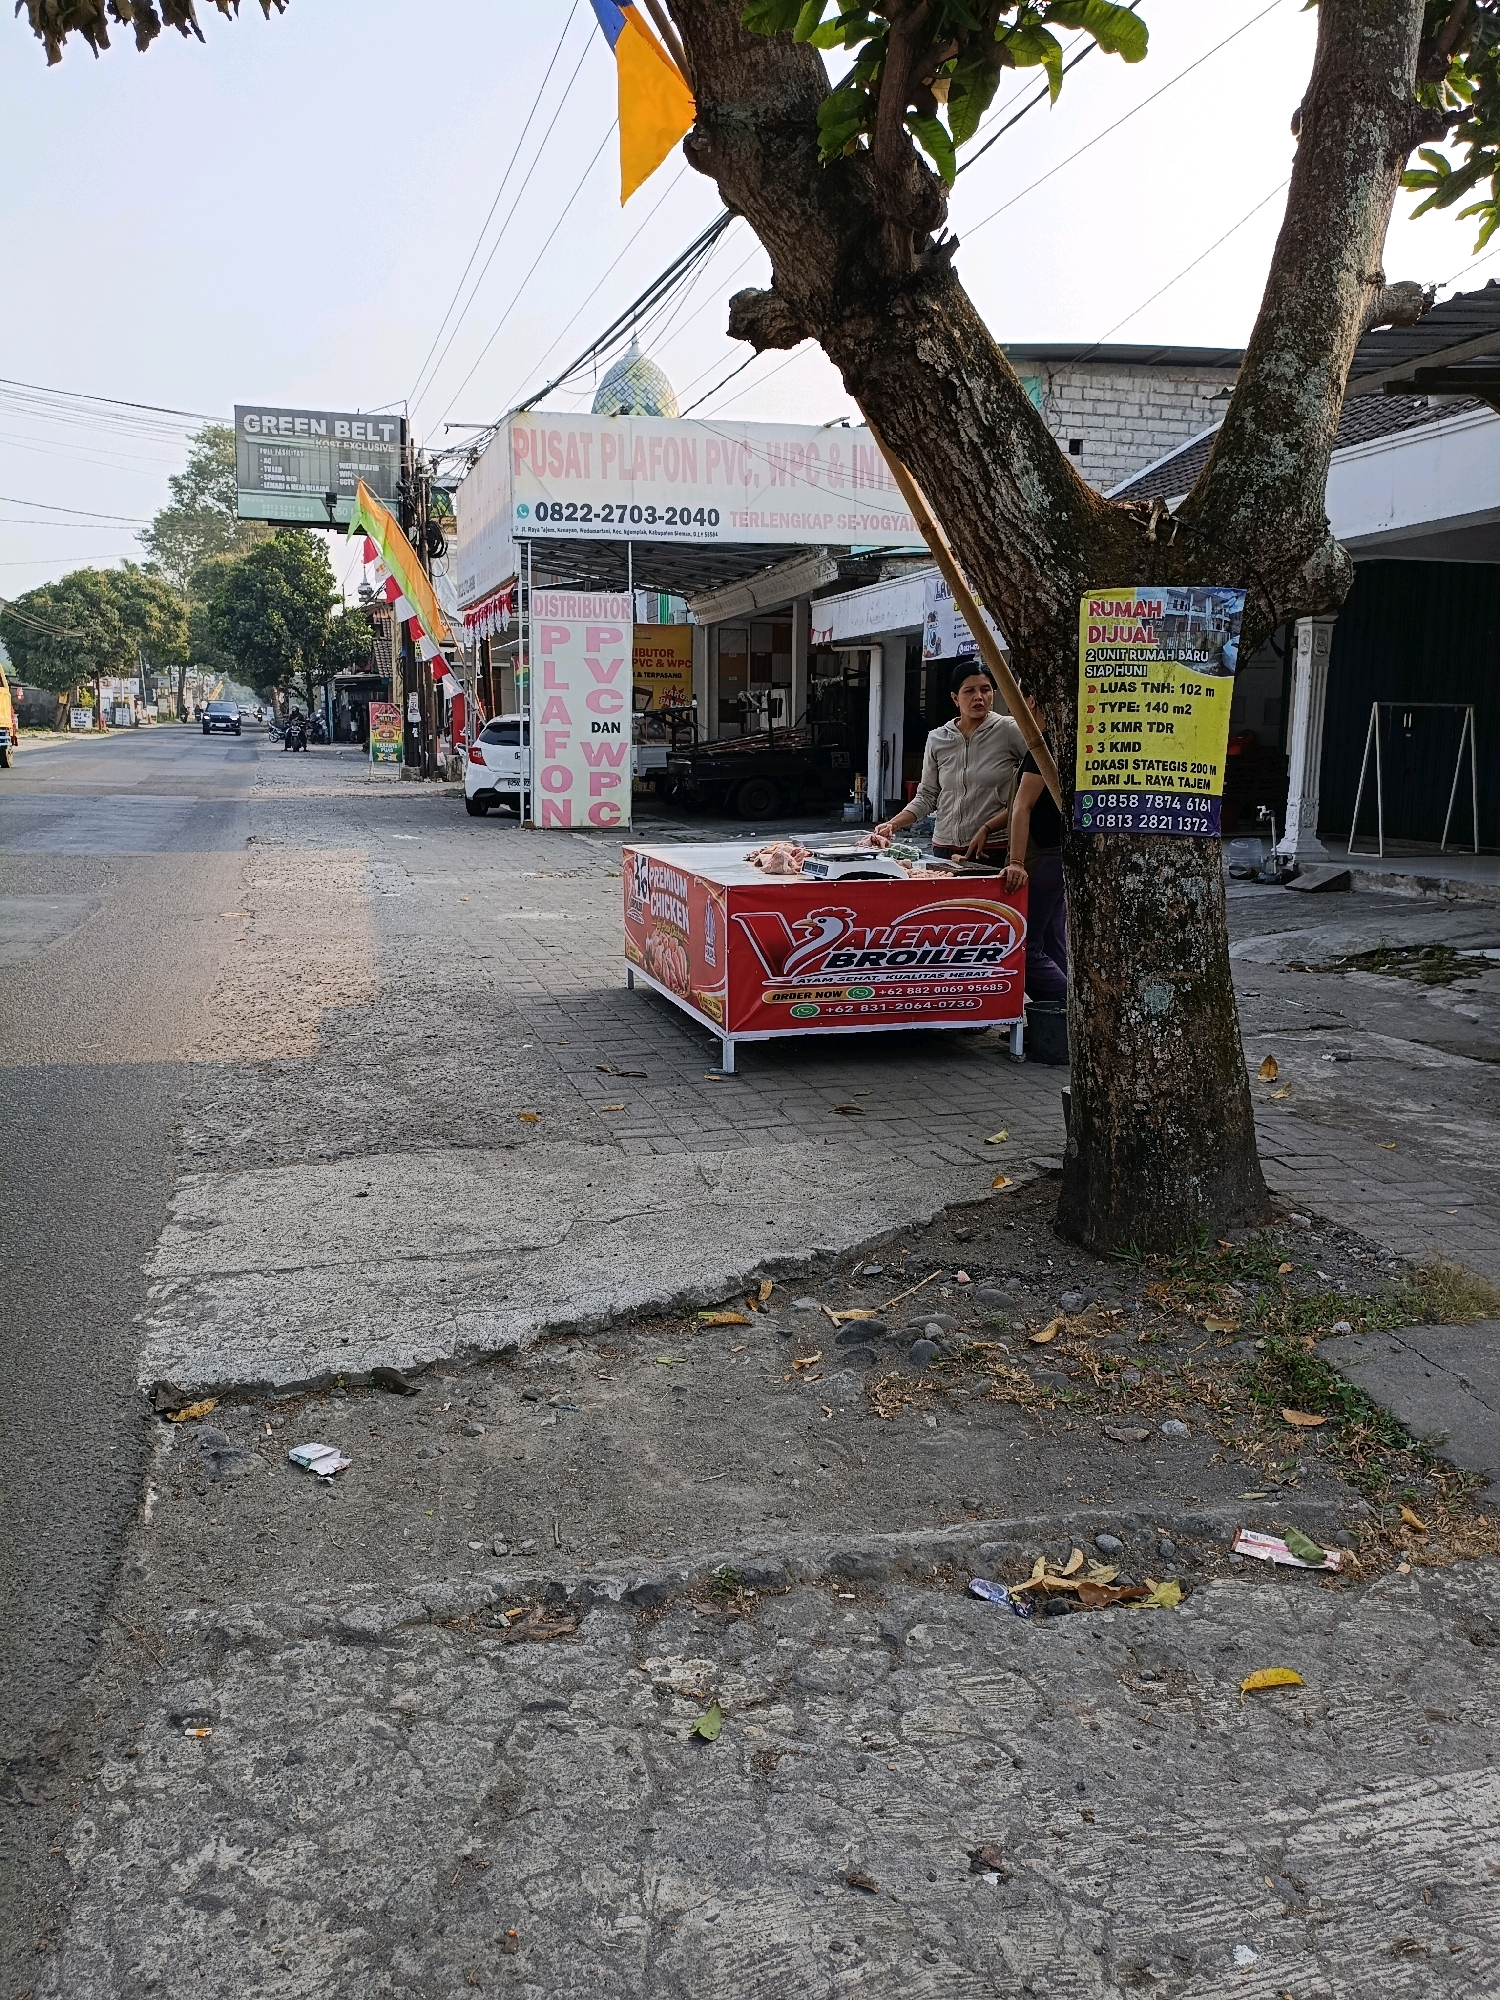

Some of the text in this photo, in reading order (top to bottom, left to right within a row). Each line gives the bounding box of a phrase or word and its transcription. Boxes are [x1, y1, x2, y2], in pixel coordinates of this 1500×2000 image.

[243, 414, 395, 442] GREEN BELT
[315, 439, 395, 453] KOST EXCLUSIVE
[513, 427, 593, 479] PUSAT
[600, 432, 698, 484] PLAFON
[705, 438, 759, 488] PVC,
[766, 441, 820, 488] WPC
[827, 442, 845, 489] &
[535, 501, 720, 527] 0822-2703-2040
[729, 510, 834, 529] TERLENGKAP
[533, 594, 632, 620] DISTRIBUTOR
[1088, 599, 1164, 619] RUMAH
[1088, 624, 1160, 645] DIJUAL
[632, 647, 675, 658] IBUTOR
[1085, 648, 1209, 662] 2 UNIT RUMAH BARU
[656, 658, 665, 668] &
[667, 659, 692, 669] WPC
[1085, 664, 1147, 677] SIAP HUNI
[644, 671, 683, 679] TERPASANG
[1099, 681, 1215, 698] LUAS TNH: 102 m
[1099, 701, 1192, 715] TYPE: 140 m2
[591, 721, 621, 734] DAN
[1097, 720, 1174, 734] 3 KMR TDR
[1096, 740, 1142, 754] 3 KMD
[1085, 758, 1217, 776] LOKASI STATEGIS 200 M
[1091, 773, 1211, 791] DARI JL. RAYA TAJEM
[1097, 794, 1211, 813] 0858 7874 6161
[1096, 814, 1208, 832] 0813 2821 1372
[649, 866, 688, 902] PREMIUM
[650, 892, 690, 936] CHICKEN
[731, 911, 1012, 980] VALENCIA
[822, 945, 1004, 971] BROILER
[796, 976, 835, 984] AYAM
[885, 972, 946, 981] KUALITAS
[771, 983, 1004, 1001] ORDER NOW +62 882 0069 95685
[825, 999, 975, 1014] +62 831-2064-0736
